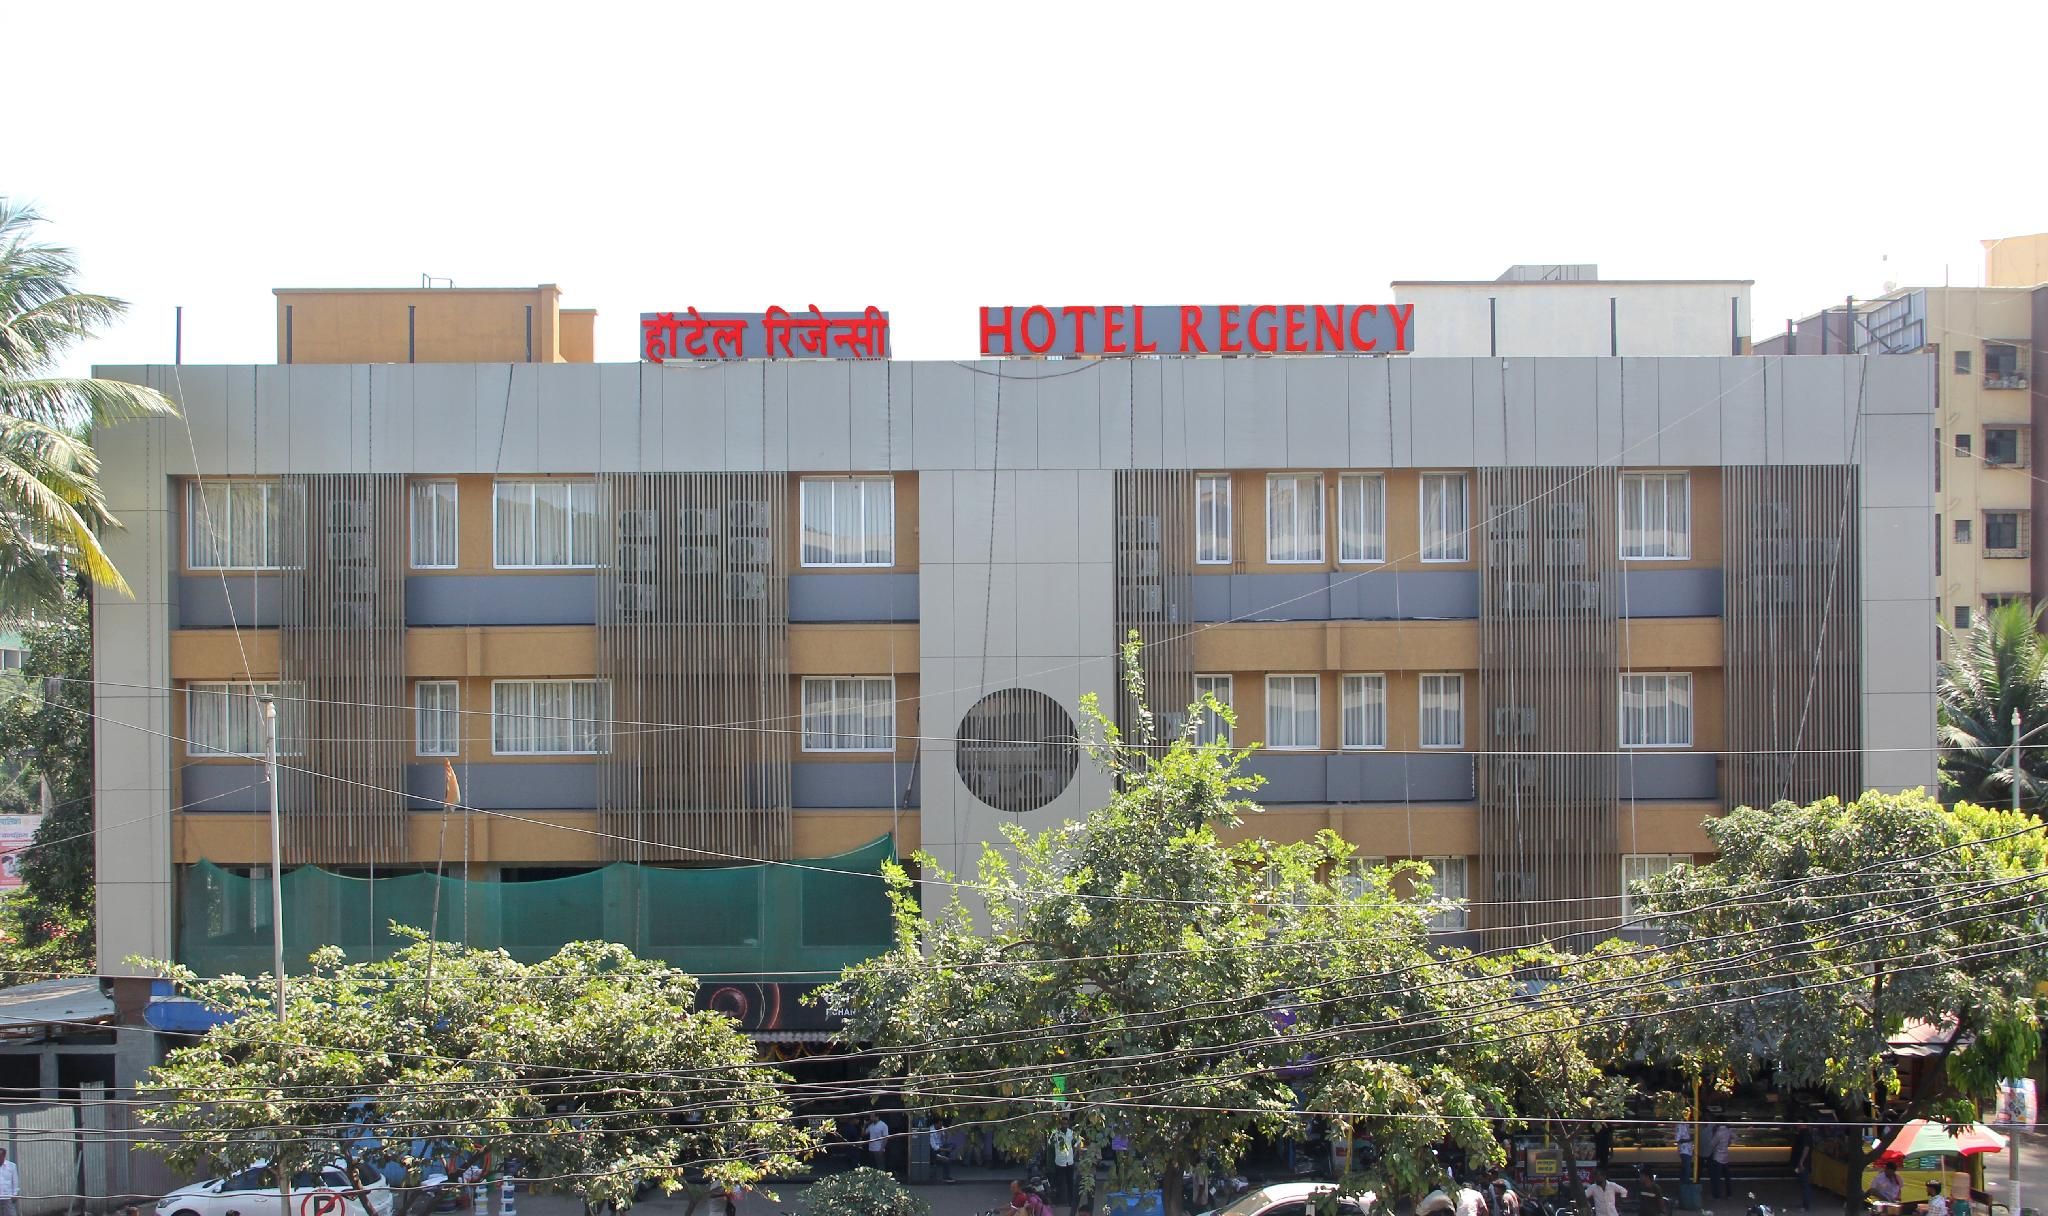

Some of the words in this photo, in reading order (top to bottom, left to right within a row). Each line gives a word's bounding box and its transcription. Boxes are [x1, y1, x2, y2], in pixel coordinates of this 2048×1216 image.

[641, 306, 748, 363] हॉटेल
[762, 304, 888, 357] रिजेन्सी
[980, 304, 1158, 353] HOTEL
[1180, 304, 1414, 352] REGENCY
